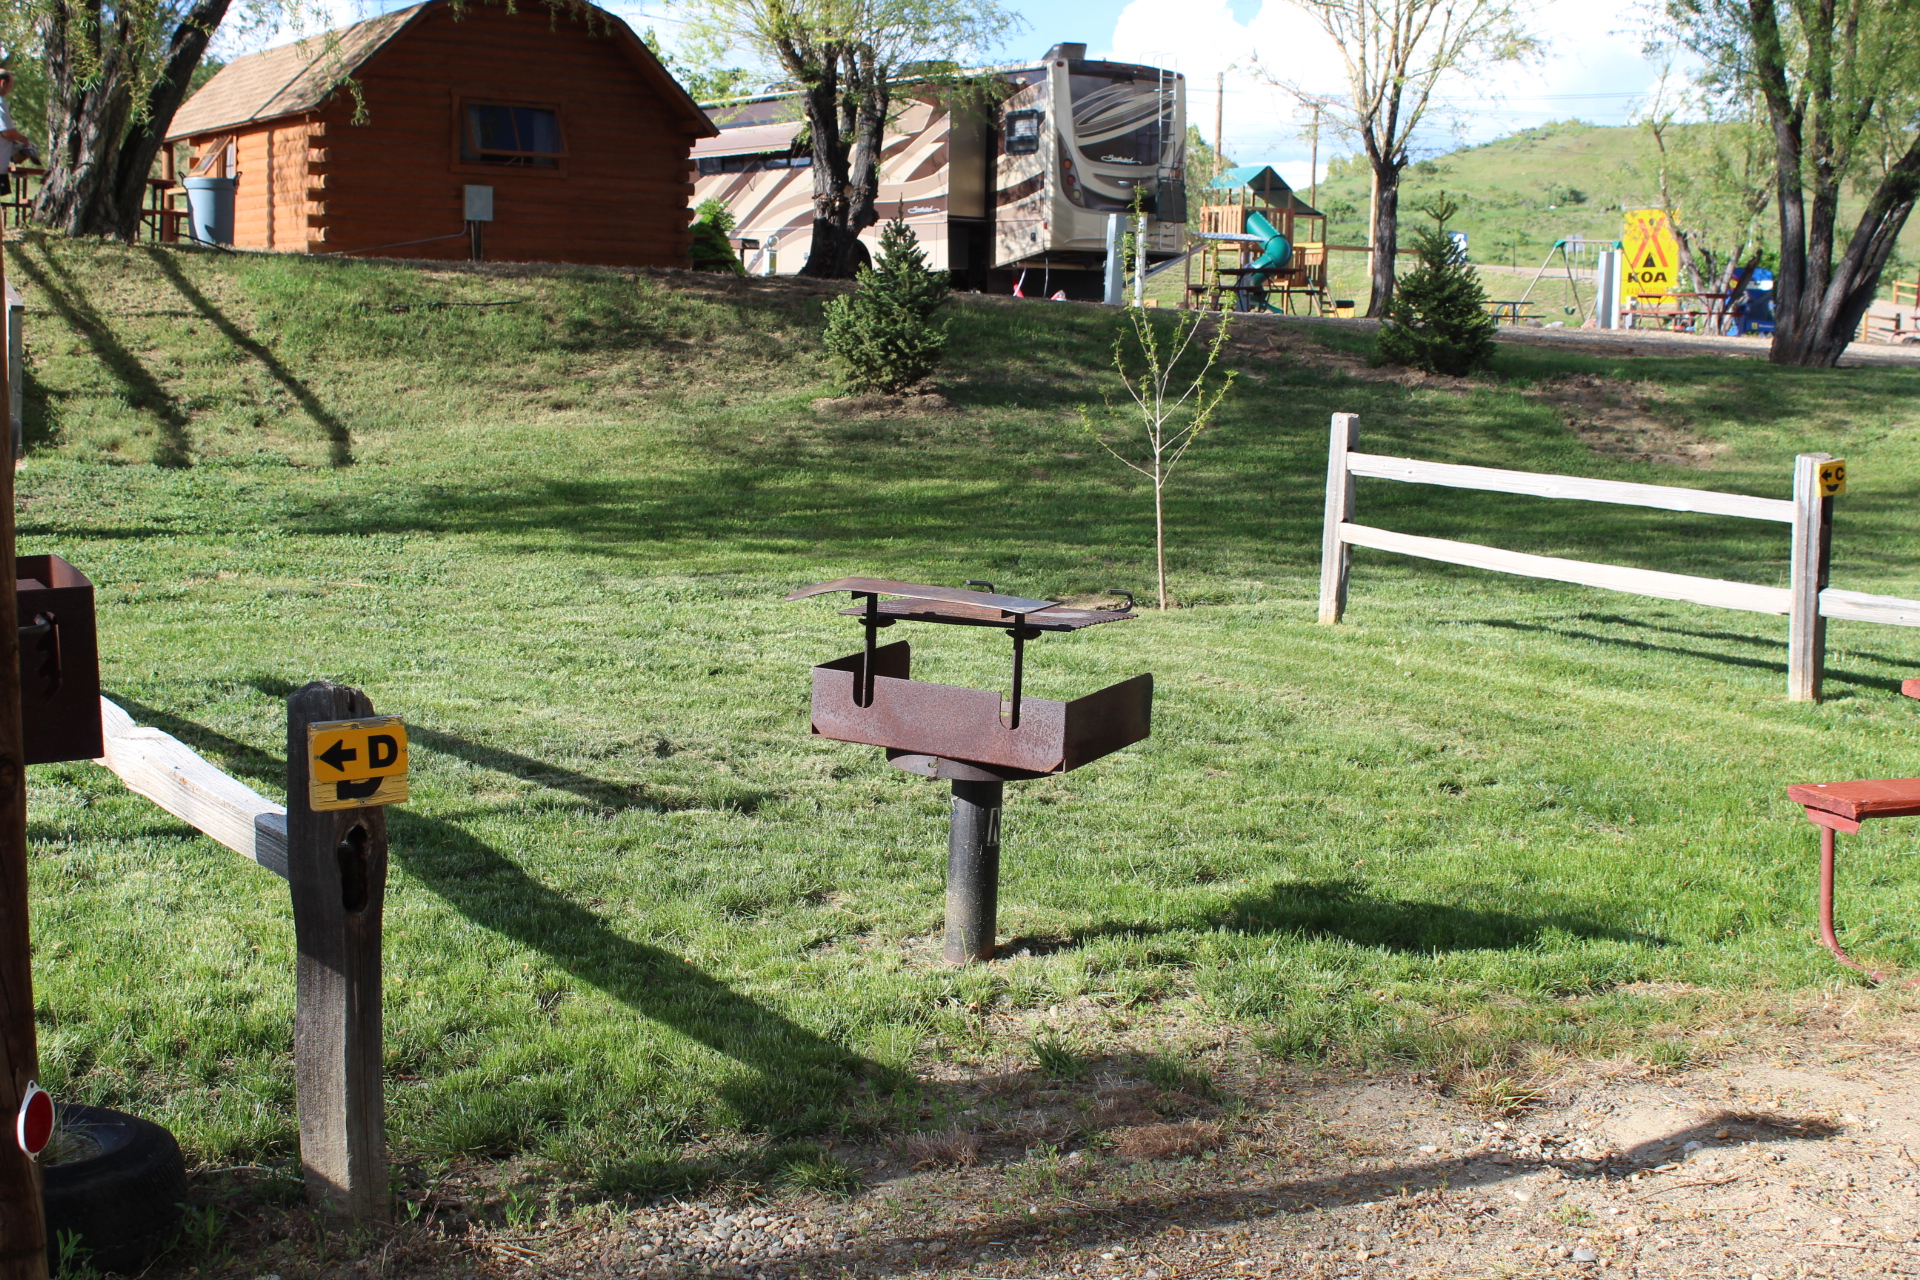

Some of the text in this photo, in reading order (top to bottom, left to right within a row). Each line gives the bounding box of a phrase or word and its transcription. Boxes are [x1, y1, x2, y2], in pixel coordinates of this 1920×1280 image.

[1628, 271, 1667, 283] KOA
[1835, 467, 1844, 481] C
[367, 734, 398, 769] D
